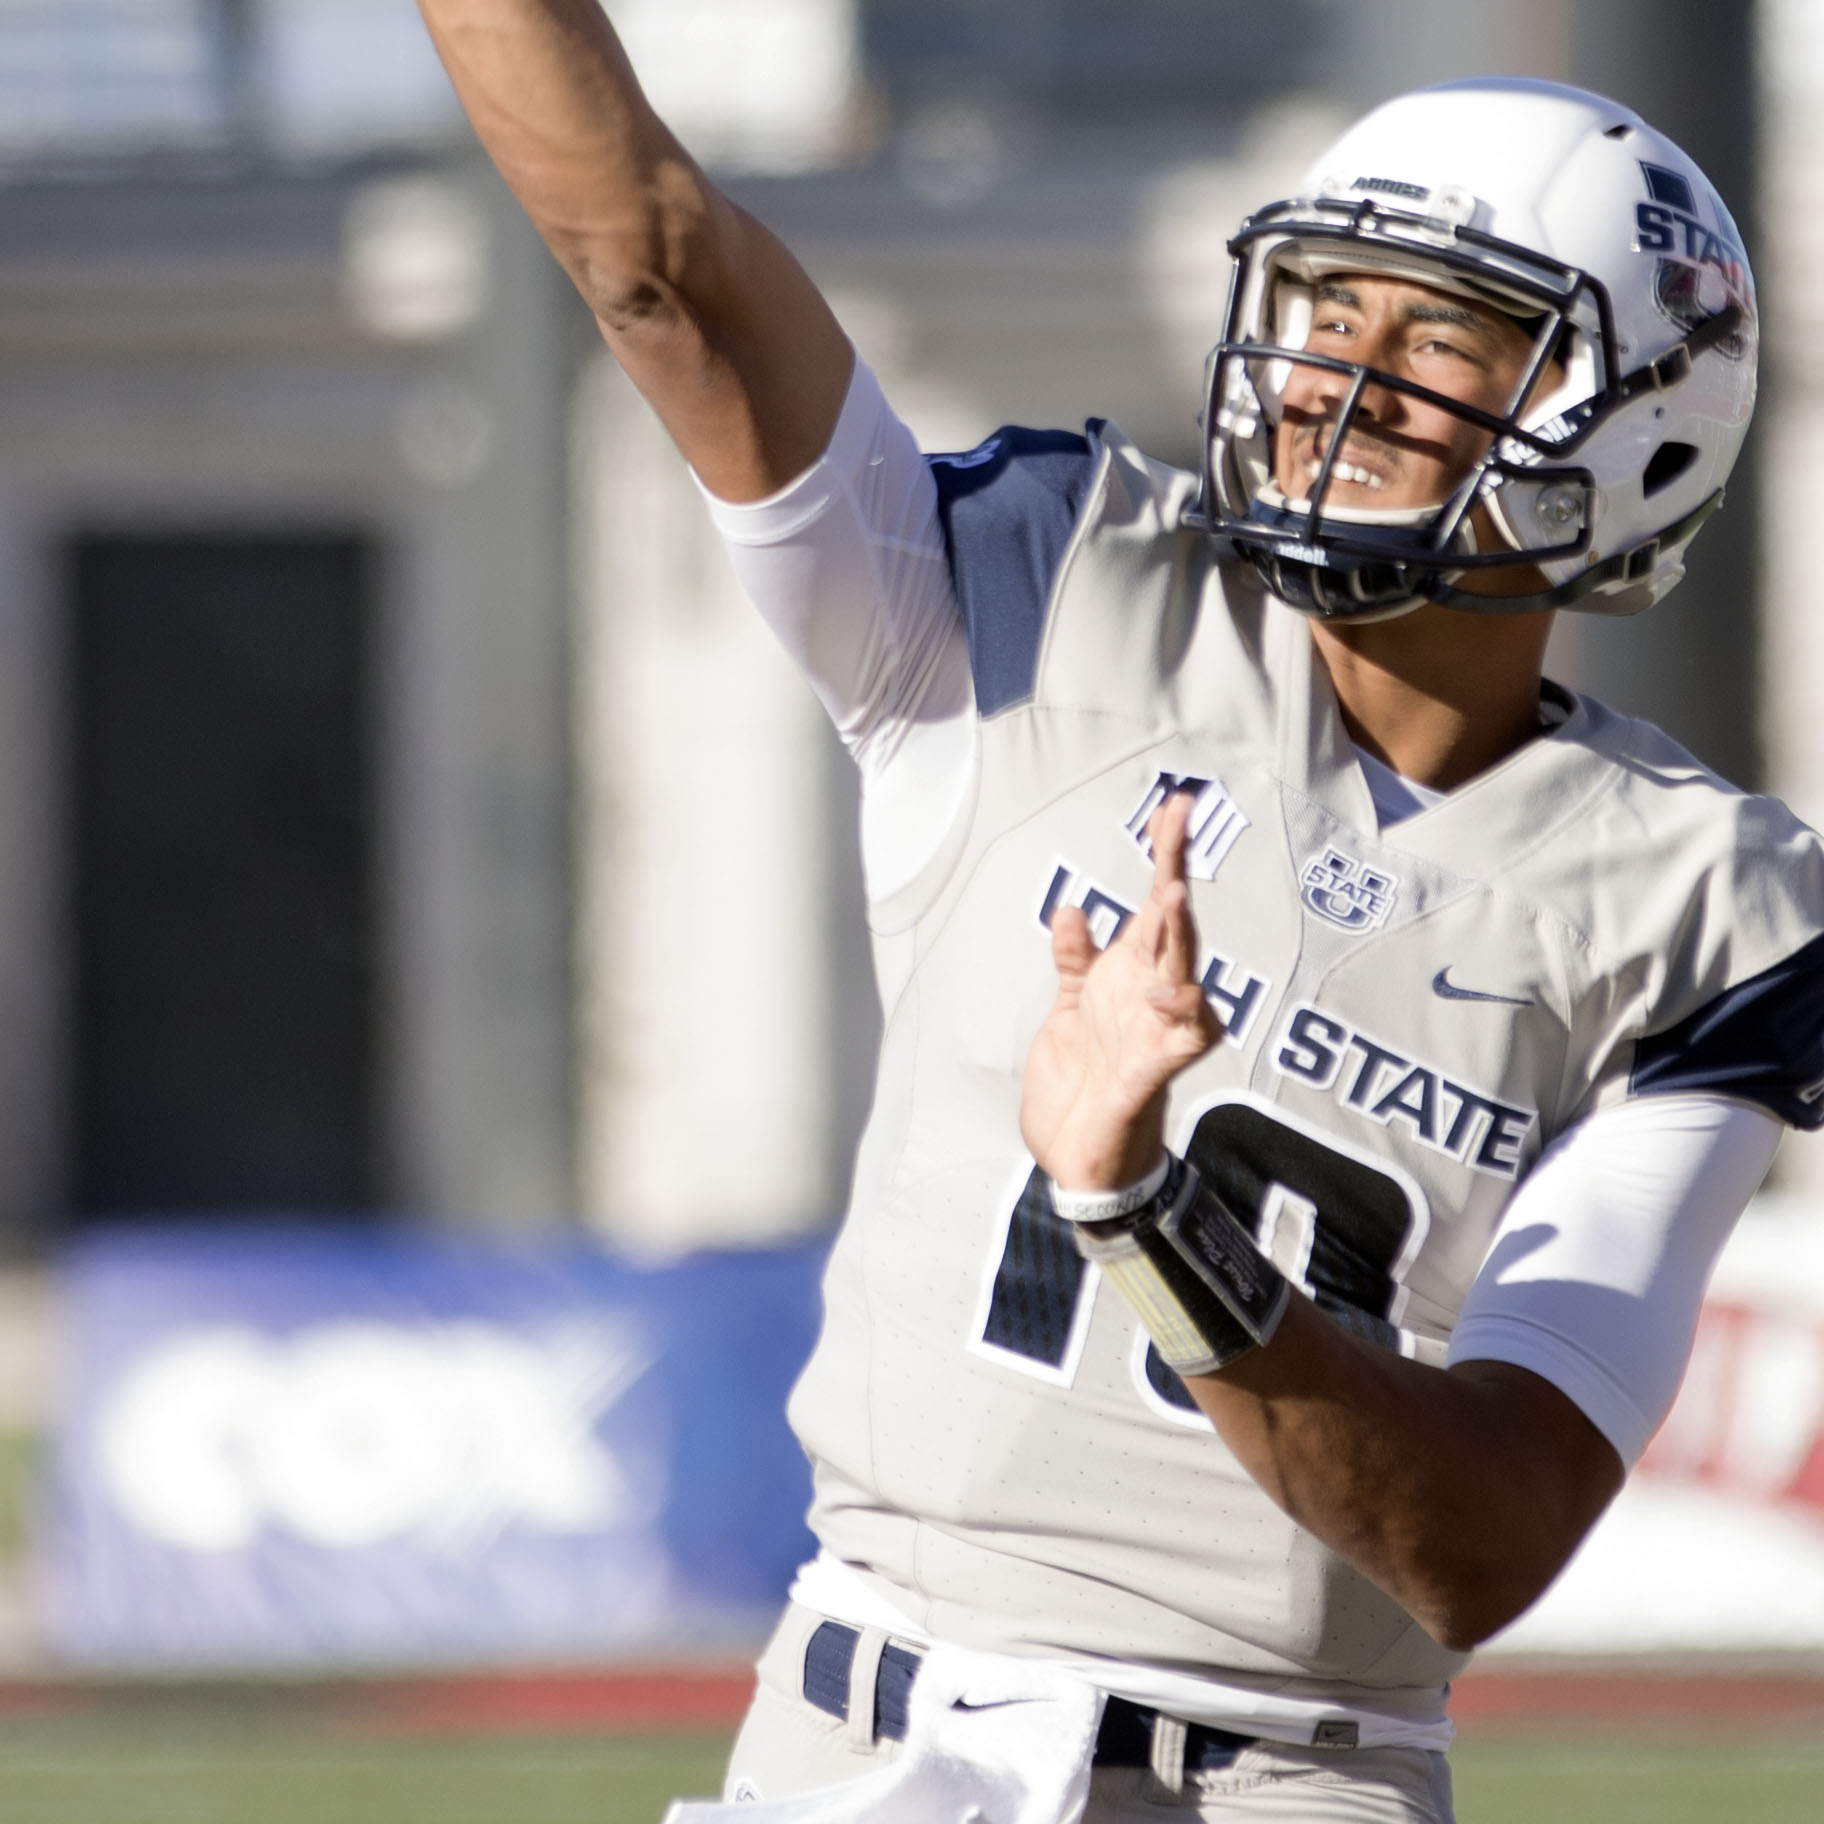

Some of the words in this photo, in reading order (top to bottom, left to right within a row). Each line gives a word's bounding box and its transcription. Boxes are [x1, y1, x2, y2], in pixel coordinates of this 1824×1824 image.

[1305, 863, 1388, 916] STATE
[1277, 1006, 1535, 1176] STATE
[101, 1316, 651, 1548] COX
